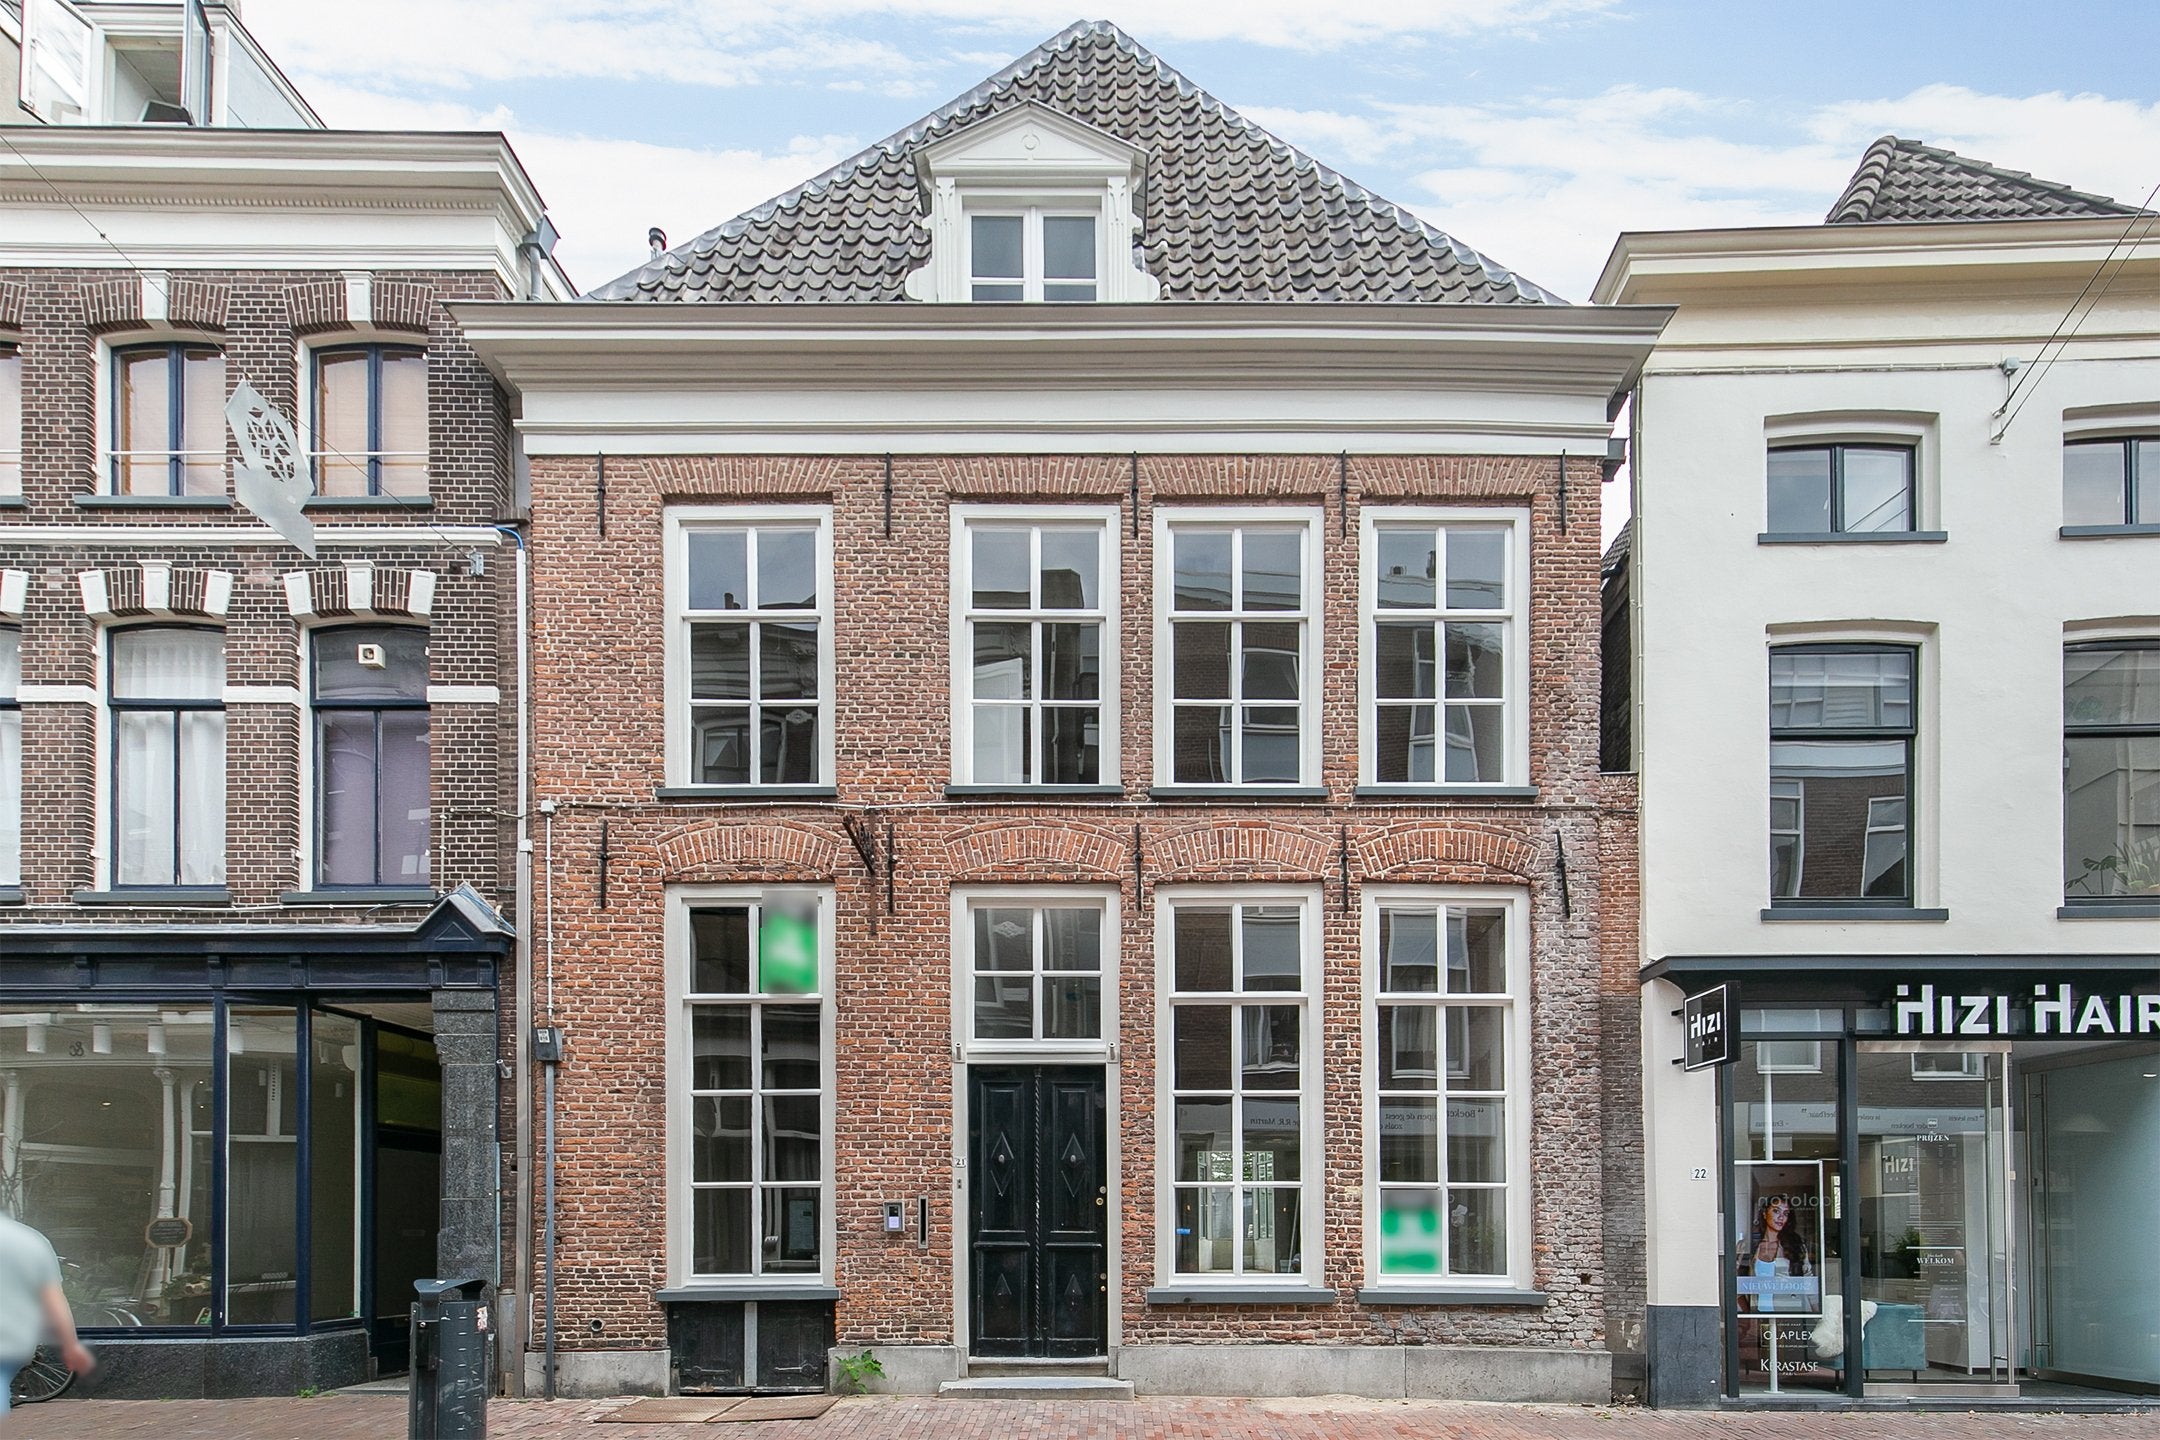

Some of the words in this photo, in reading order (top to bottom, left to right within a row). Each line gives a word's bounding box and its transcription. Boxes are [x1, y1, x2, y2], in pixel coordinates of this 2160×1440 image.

[1896, 984, 2009, 1034] HIZI
[1690, 1011, 1721, 1039] HIZI
[956, 1158, 965, 1166] 21
[1694, 1168, 1707, 1179] 22
[1742, 1282, 1777, 1291] NIEUWE
